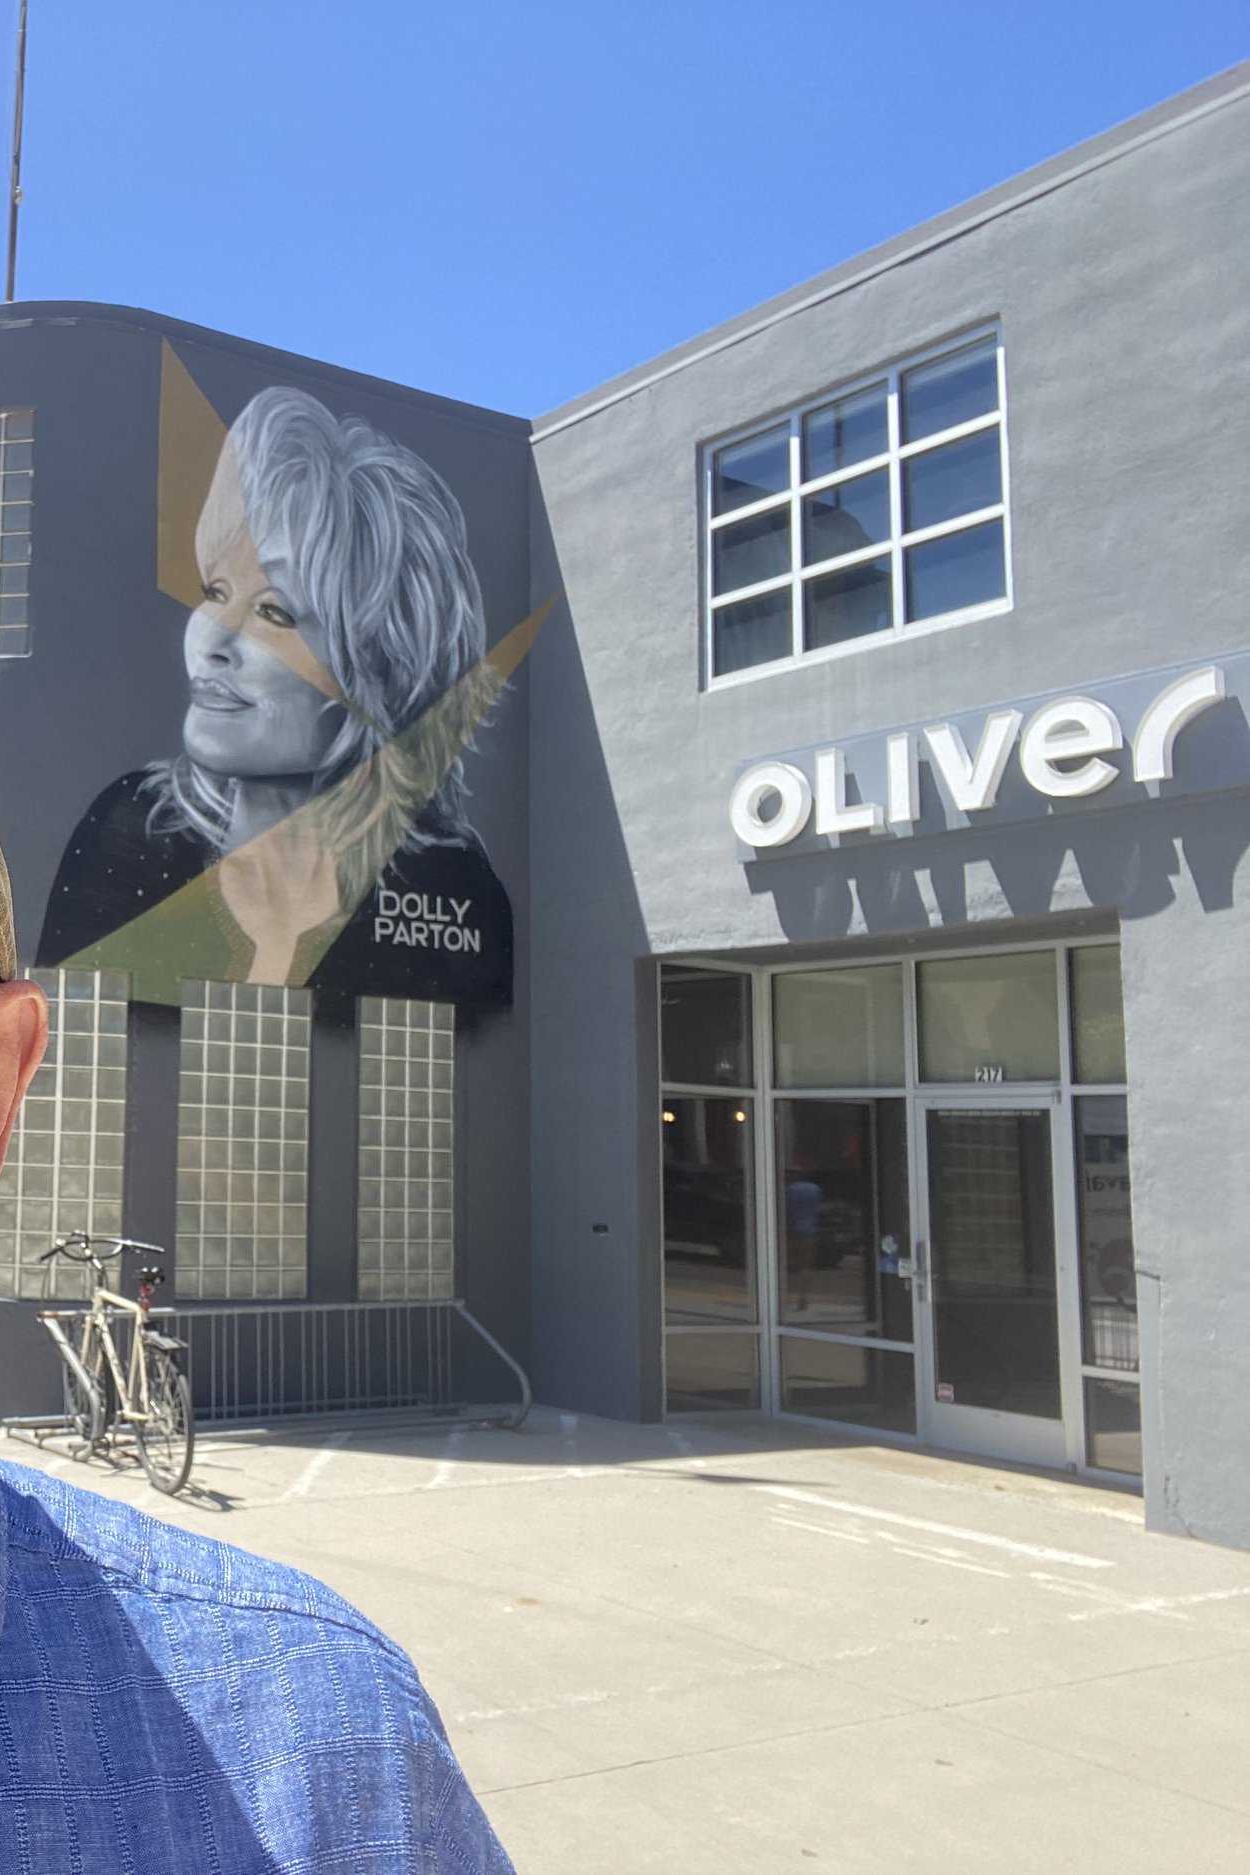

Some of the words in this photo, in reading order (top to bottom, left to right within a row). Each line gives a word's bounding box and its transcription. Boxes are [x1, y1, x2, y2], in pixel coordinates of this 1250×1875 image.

[378, 889, 471, 925] DOLLY
[374, 917, 480, 953] PARTON
[975, 1066, 1003, 1083] 217
